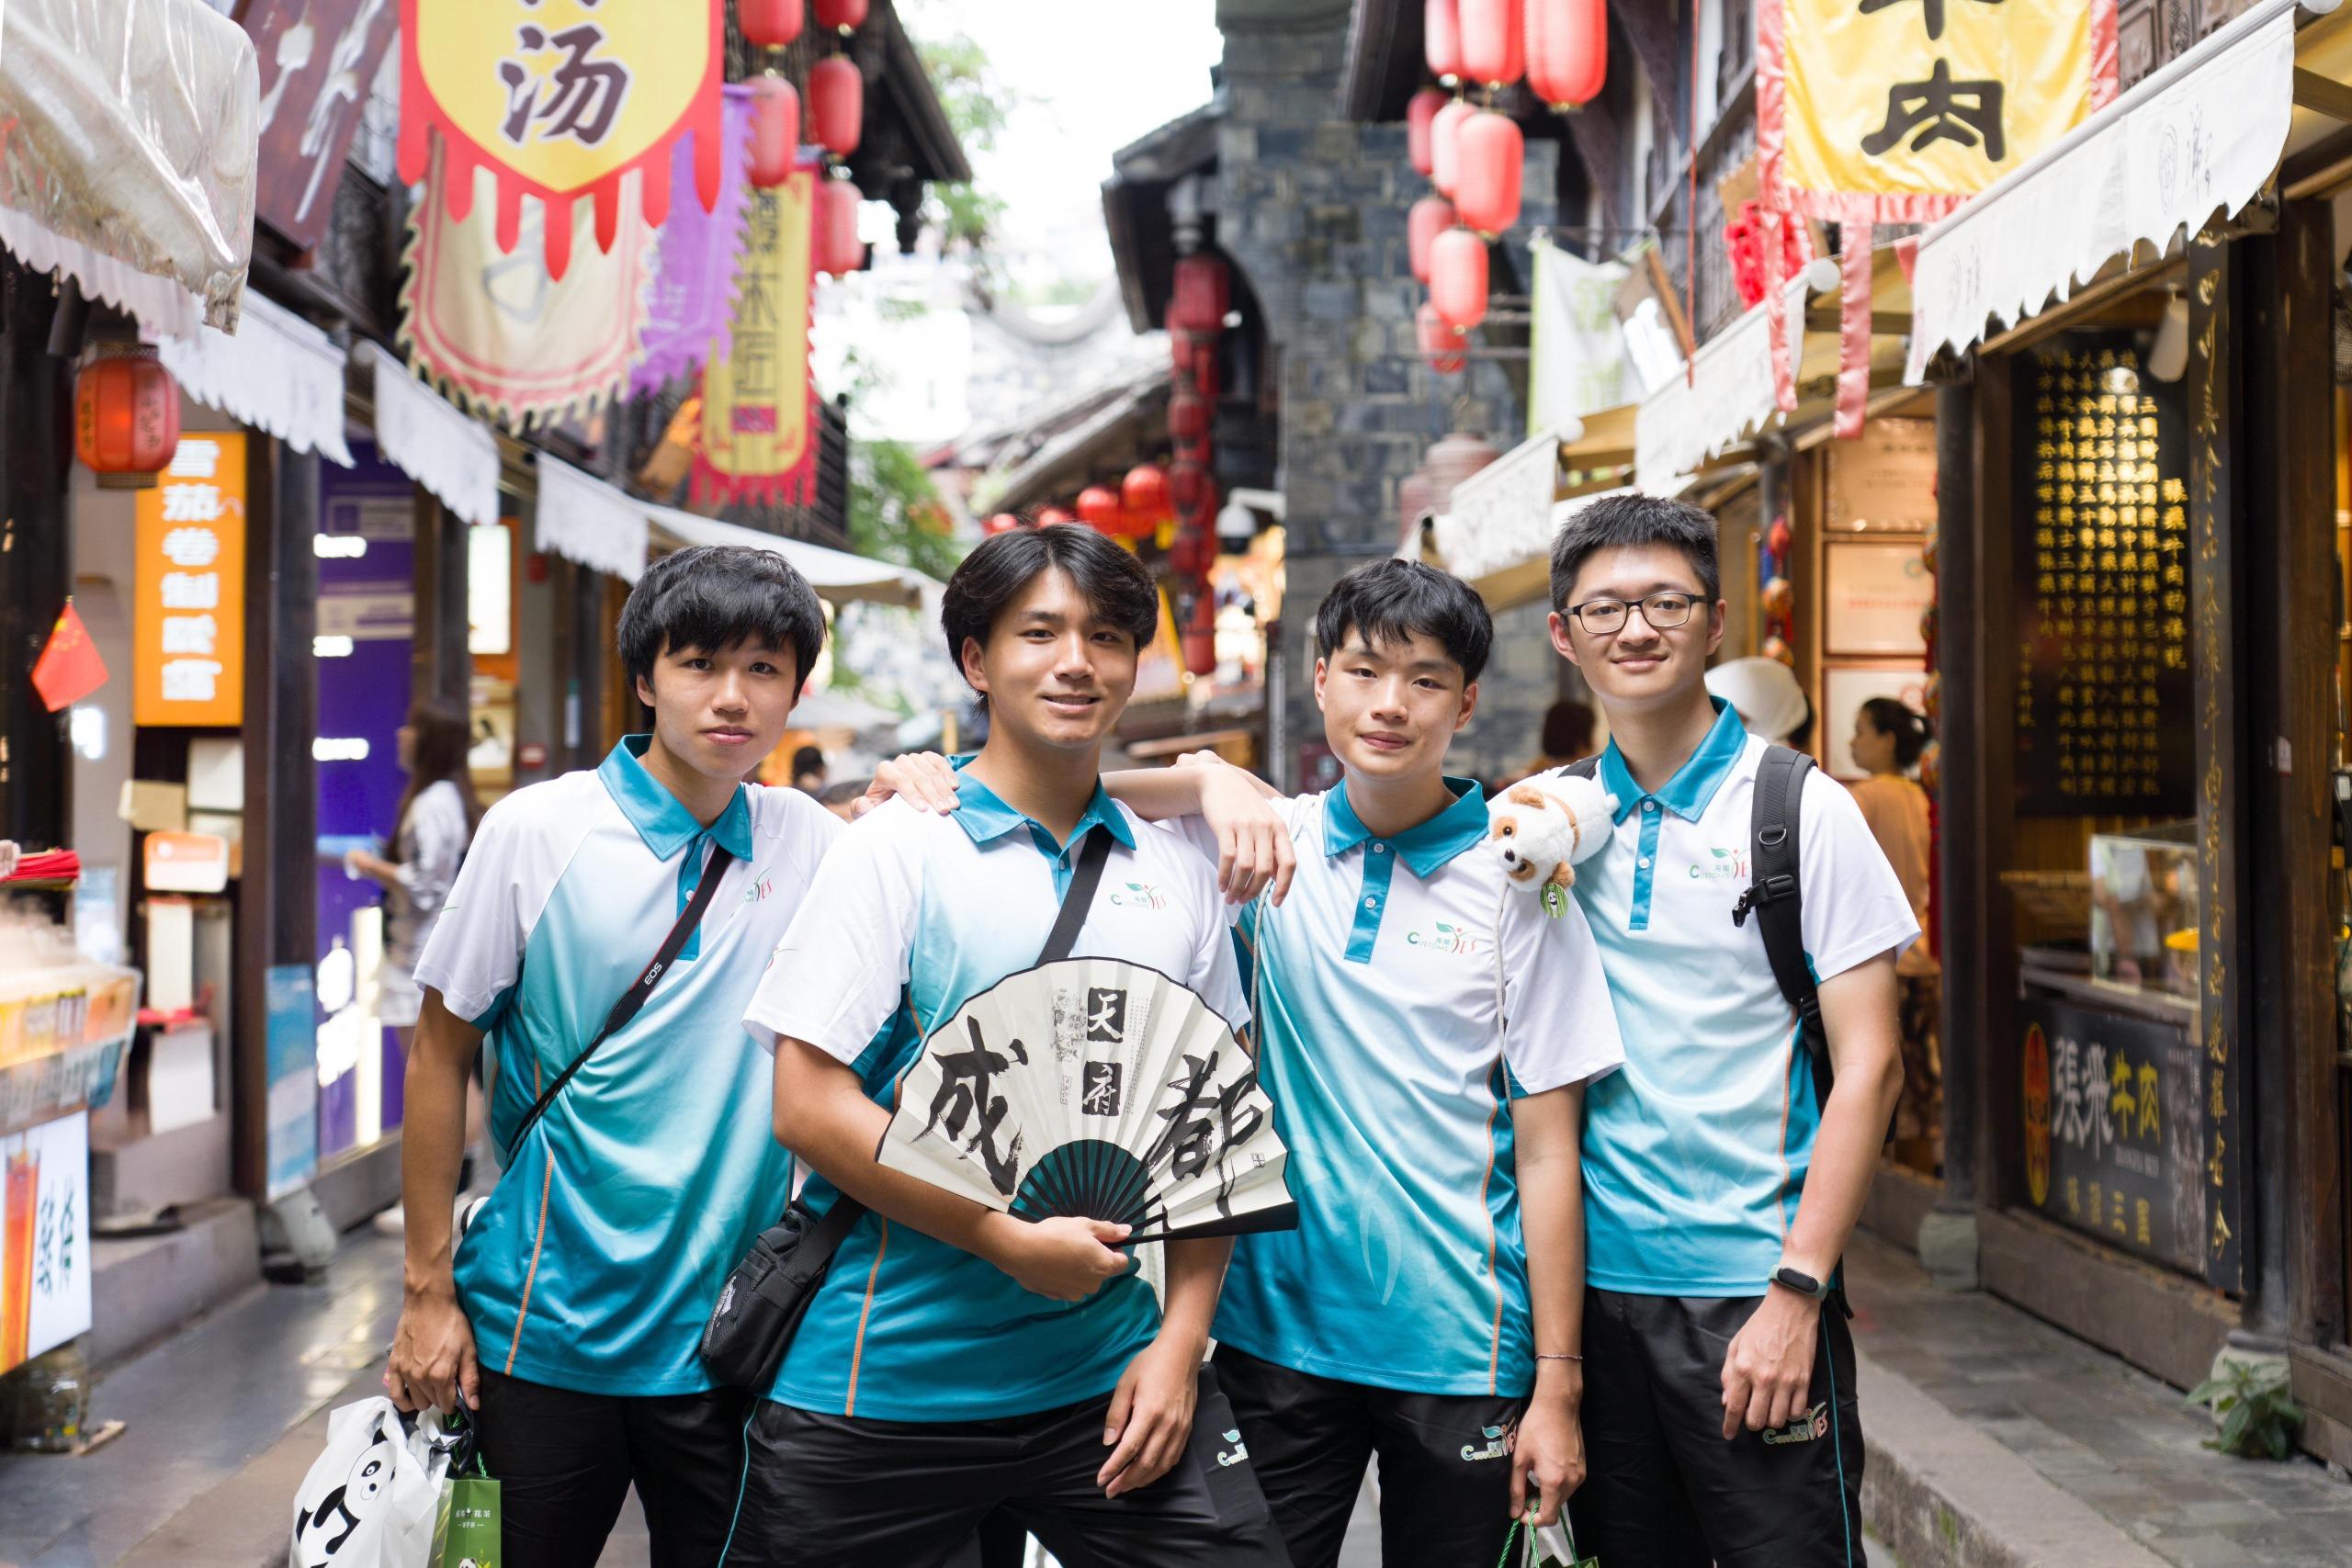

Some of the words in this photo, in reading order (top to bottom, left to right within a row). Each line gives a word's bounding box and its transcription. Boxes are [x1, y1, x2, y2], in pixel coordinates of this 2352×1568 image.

[500, 0, 628, 145] 汤
[644, 962, 662, 986] EOS
[1082, 988, 1126, 1116] 天府
[2053, 1035, 2161, 1160] 張飛牛肉
